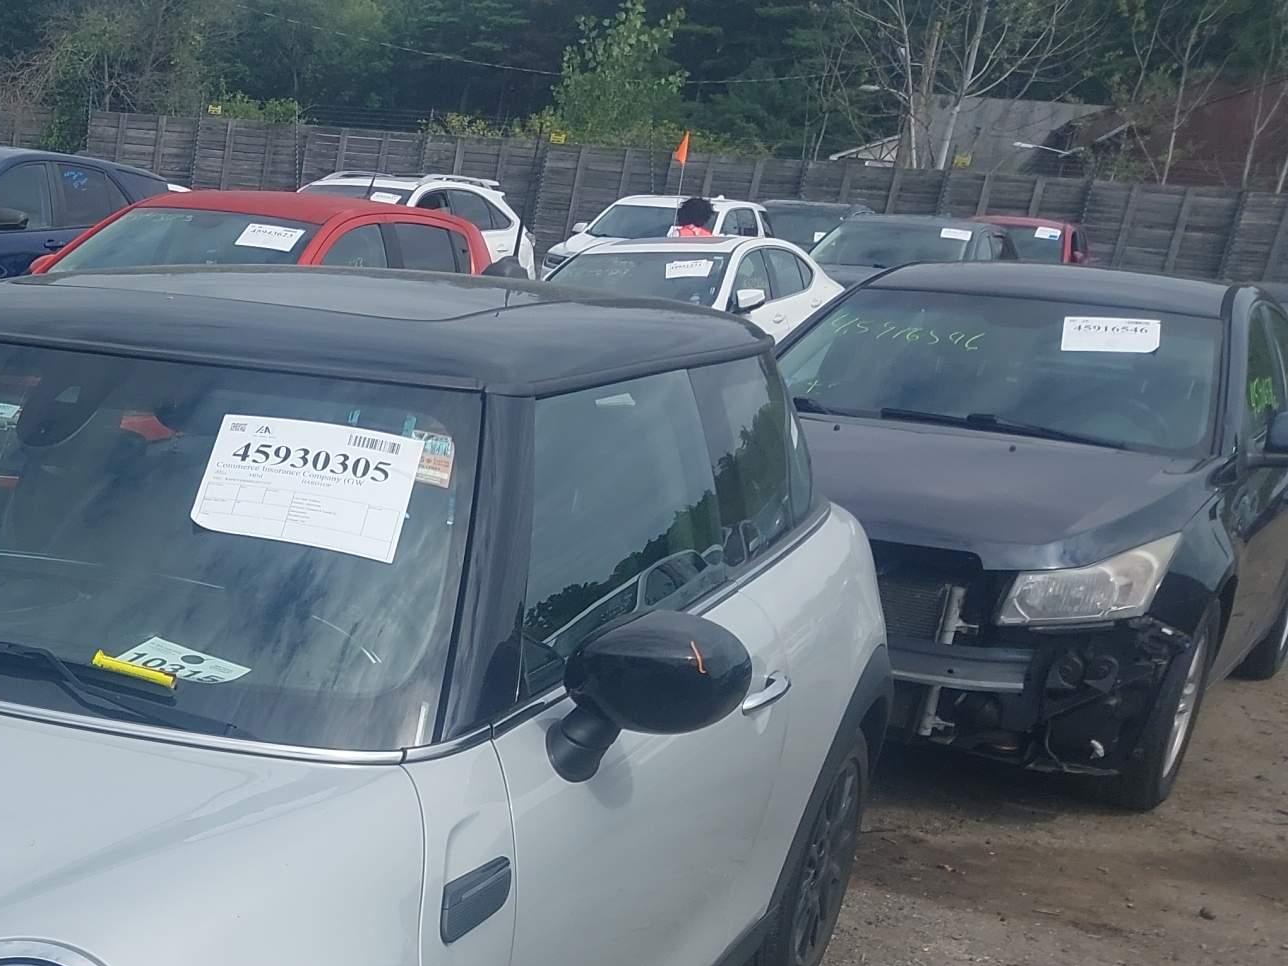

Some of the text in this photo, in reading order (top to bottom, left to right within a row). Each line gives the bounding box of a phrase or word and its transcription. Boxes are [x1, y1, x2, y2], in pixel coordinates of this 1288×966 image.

[216, 461, 261, 472] Commerce
[262, 465, 301, 477] Insurance
[301, 470, 342, 484] Company
[232, 441, 392, 483] 45930305
